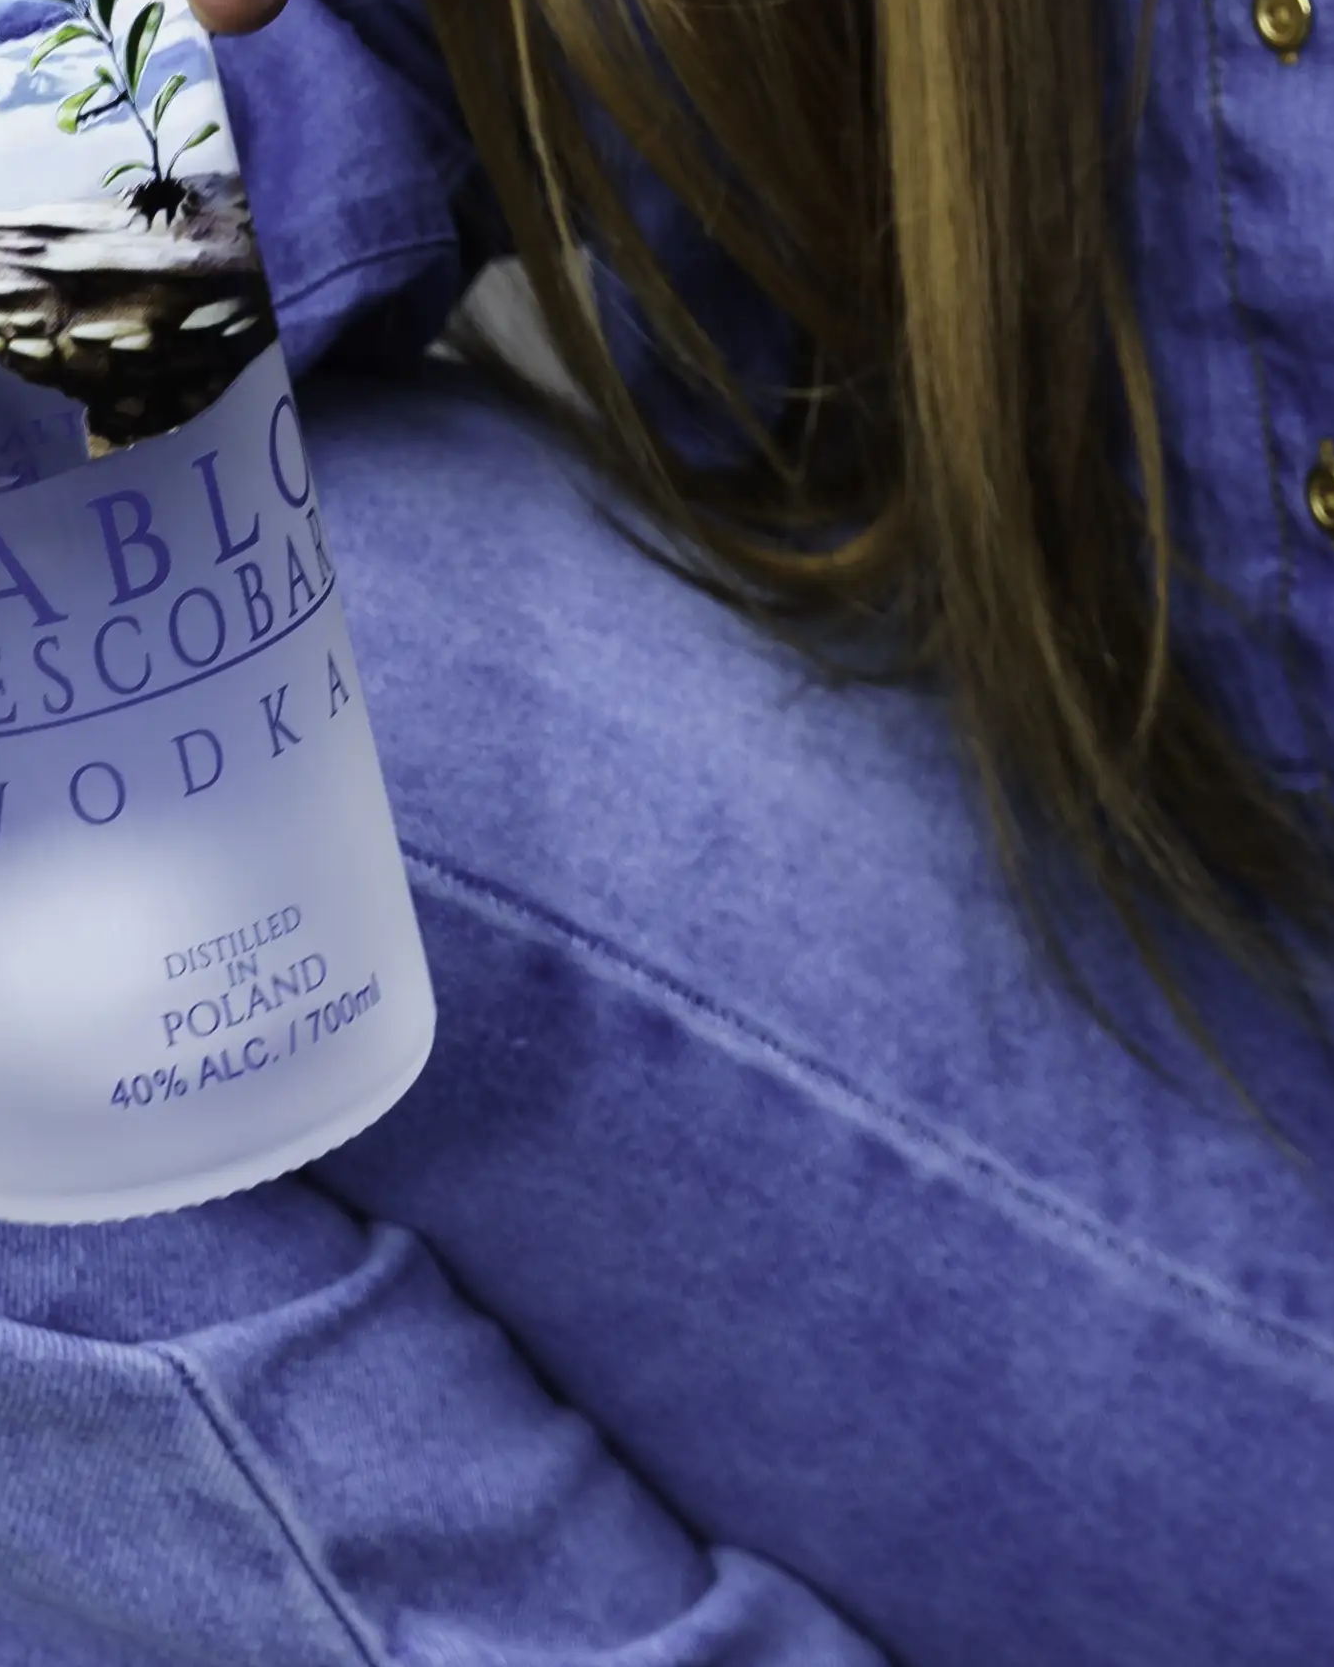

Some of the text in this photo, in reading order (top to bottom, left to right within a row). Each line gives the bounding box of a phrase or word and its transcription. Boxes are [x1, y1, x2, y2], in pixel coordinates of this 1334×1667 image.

[163, 904, 302, 980] DISTILLED
[225, 953, 258, 988] IN
[110, 1064, 189, 1110] 40%
[198, 1036, 280, 1090] ALC.
[304, 970, 382, 1044] 700ml
[161, 953, 328, 1048] POLAND
